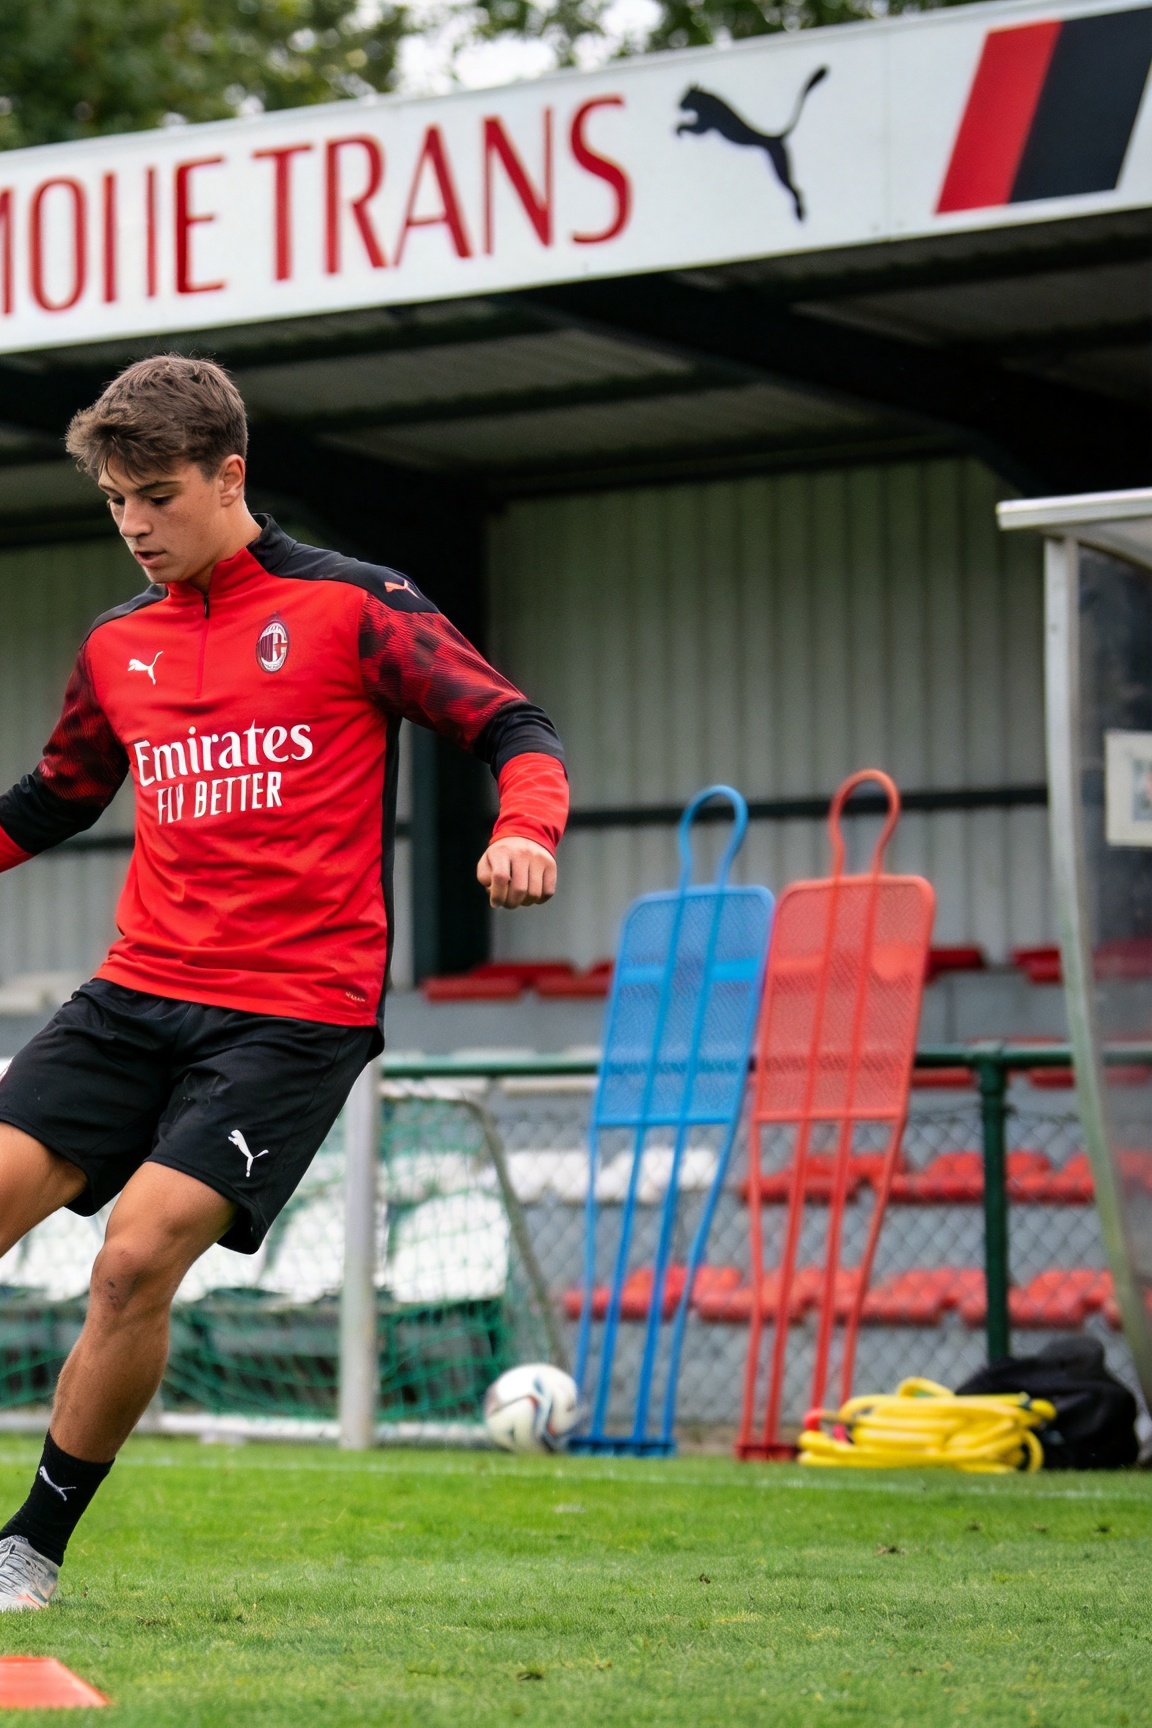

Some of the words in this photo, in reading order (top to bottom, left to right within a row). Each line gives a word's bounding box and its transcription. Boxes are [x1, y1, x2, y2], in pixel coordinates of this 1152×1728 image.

[252, 92, 632, 283] TRANS
[134, 719, 314, 788] Emirates
[193, 771, 283, 818] BETTER
